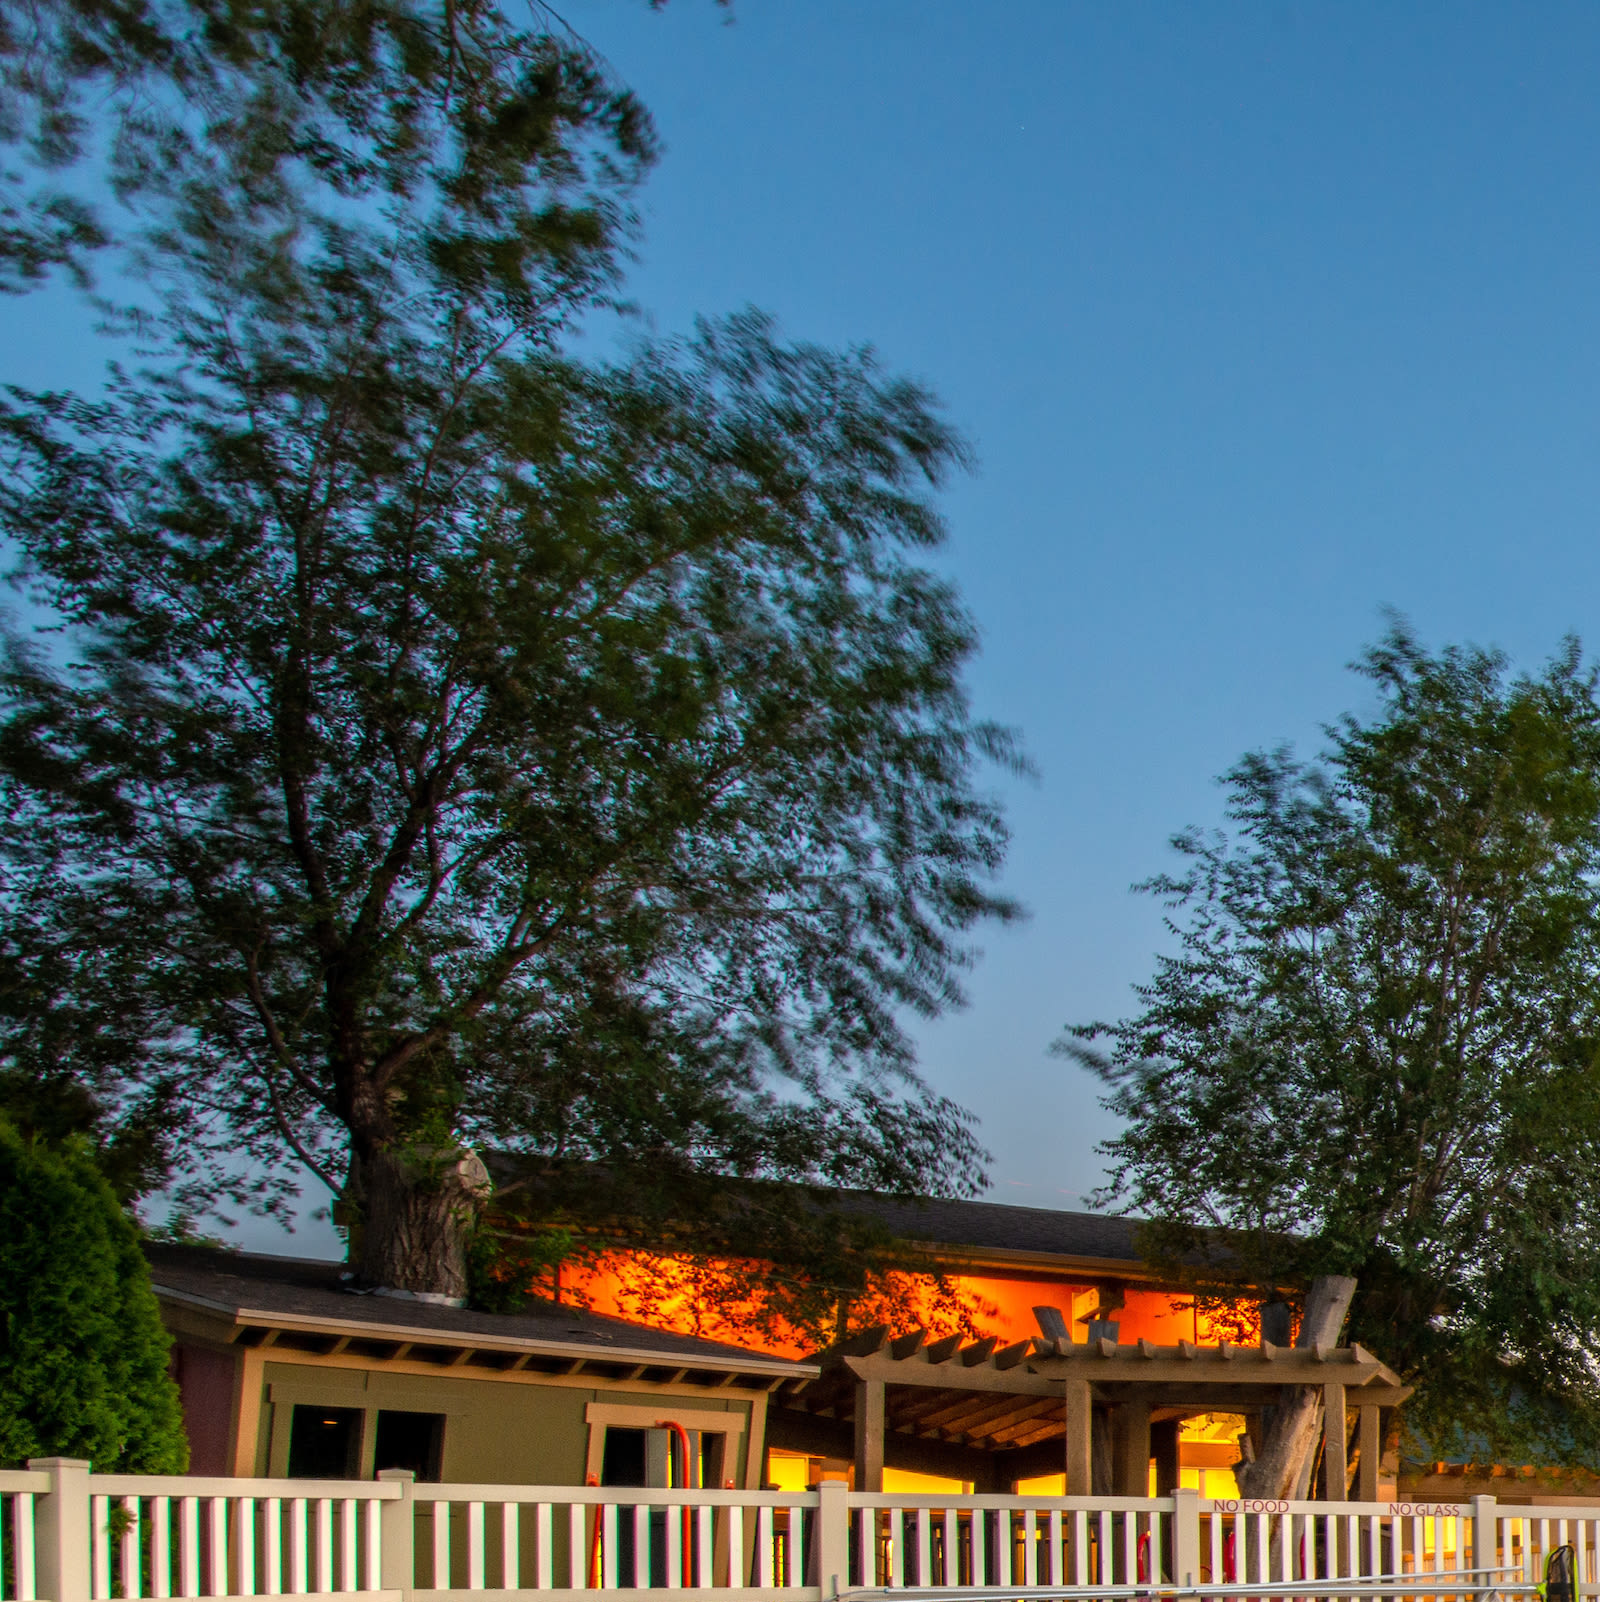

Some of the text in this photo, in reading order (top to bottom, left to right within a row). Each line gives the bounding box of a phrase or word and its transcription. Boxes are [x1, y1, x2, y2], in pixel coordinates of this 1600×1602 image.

[1213, 1499, 1290, 1513] NO FOOD
[1389, 1503, 1460, 1517] NO GLASS
